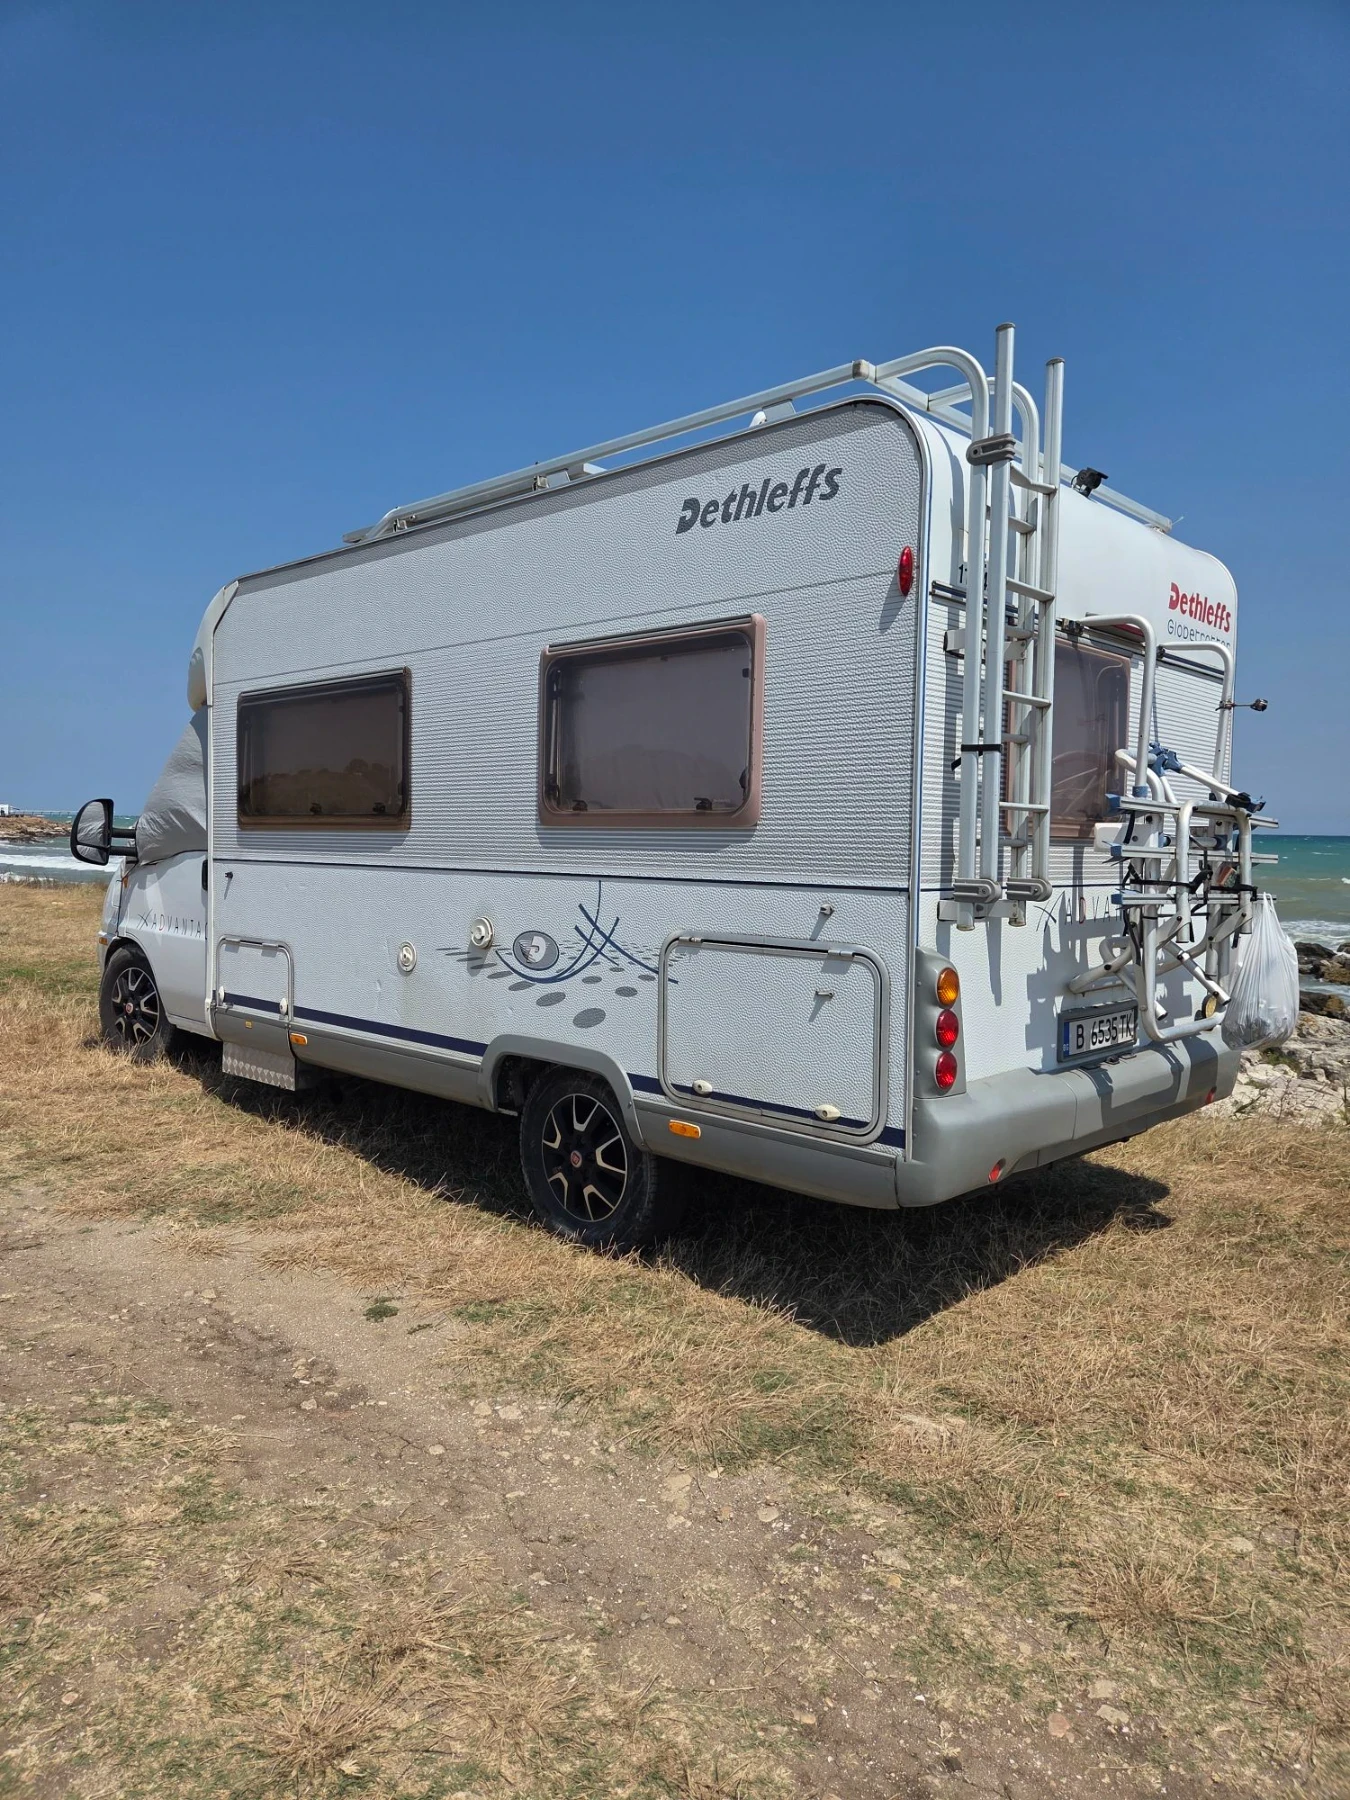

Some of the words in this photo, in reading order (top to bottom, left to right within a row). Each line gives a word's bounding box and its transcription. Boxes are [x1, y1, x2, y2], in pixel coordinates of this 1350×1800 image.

[675, 463, 843, 534] Dethleffs
[1168, 581, 1231, 633] Dethleffs
[1076, 1023, 1084, 1050] B
[1091, 1016, 1118, 1047] 6535
[1120, 1012, 1132, 1039] TK
